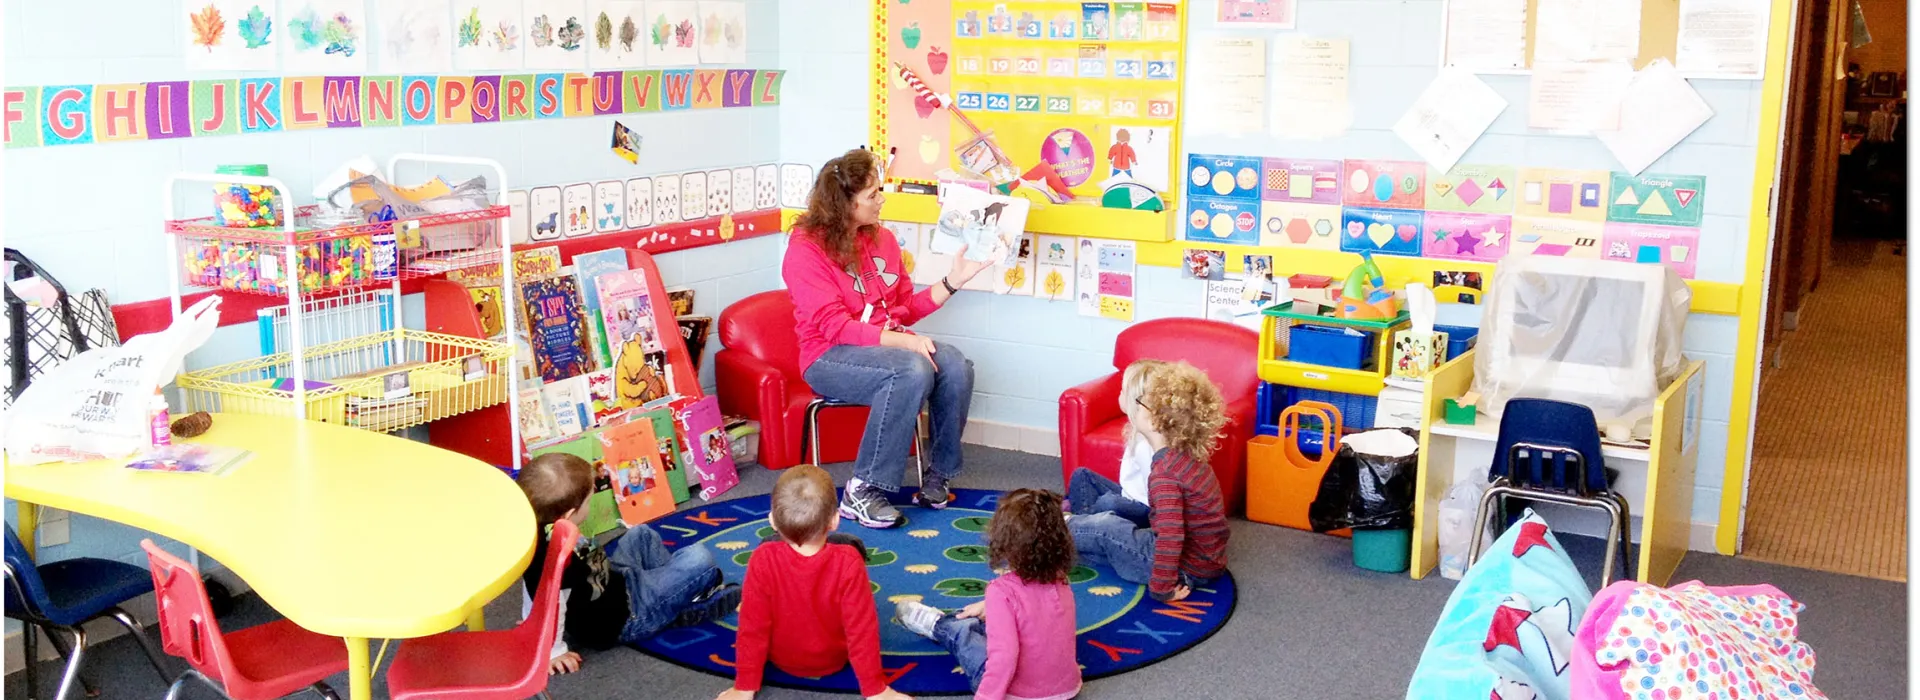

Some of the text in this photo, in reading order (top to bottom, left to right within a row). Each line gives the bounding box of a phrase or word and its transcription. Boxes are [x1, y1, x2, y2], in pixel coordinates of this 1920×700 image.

[963, 60, 1172, 76] 18 19 20 21 22 23 24
[4, 71, 779, 143] F G H I J K L M N O P Q R S T U V W X Y Z
[960, 94, 1169, 115] 25 26 27 28 29 30 31
[1078, 157, 1091, 166] THE
[1215, 159, 1234, 168] Circle
[1290, 162, 1315, 172] Square
[1641, 177, 1674, 189] Triangle
[536, 193, 542, 206] 1
[567, 191, 574, 204] 2
[600, 188, 607, 200] 3
[1209, 201, 1238, 212] Octagon
[1372, 211, 1393, 221] Heart
[1460, 217, 1476, 226] Star
[1236, 218, 1255, 227] STOP
[1630, 229, 1671, 241] Trapezoid
[1100, 249, 1108, 260] 3
[1209, 283, 1240, 294] Scienc
[546, 296, 567, 318] SPY
[1209, 295, 1241, 307] Center
[685, 510, 739, 527] K
[1116, 620, 1184, 645] X
[1087, 639, 1144, 662] Y
